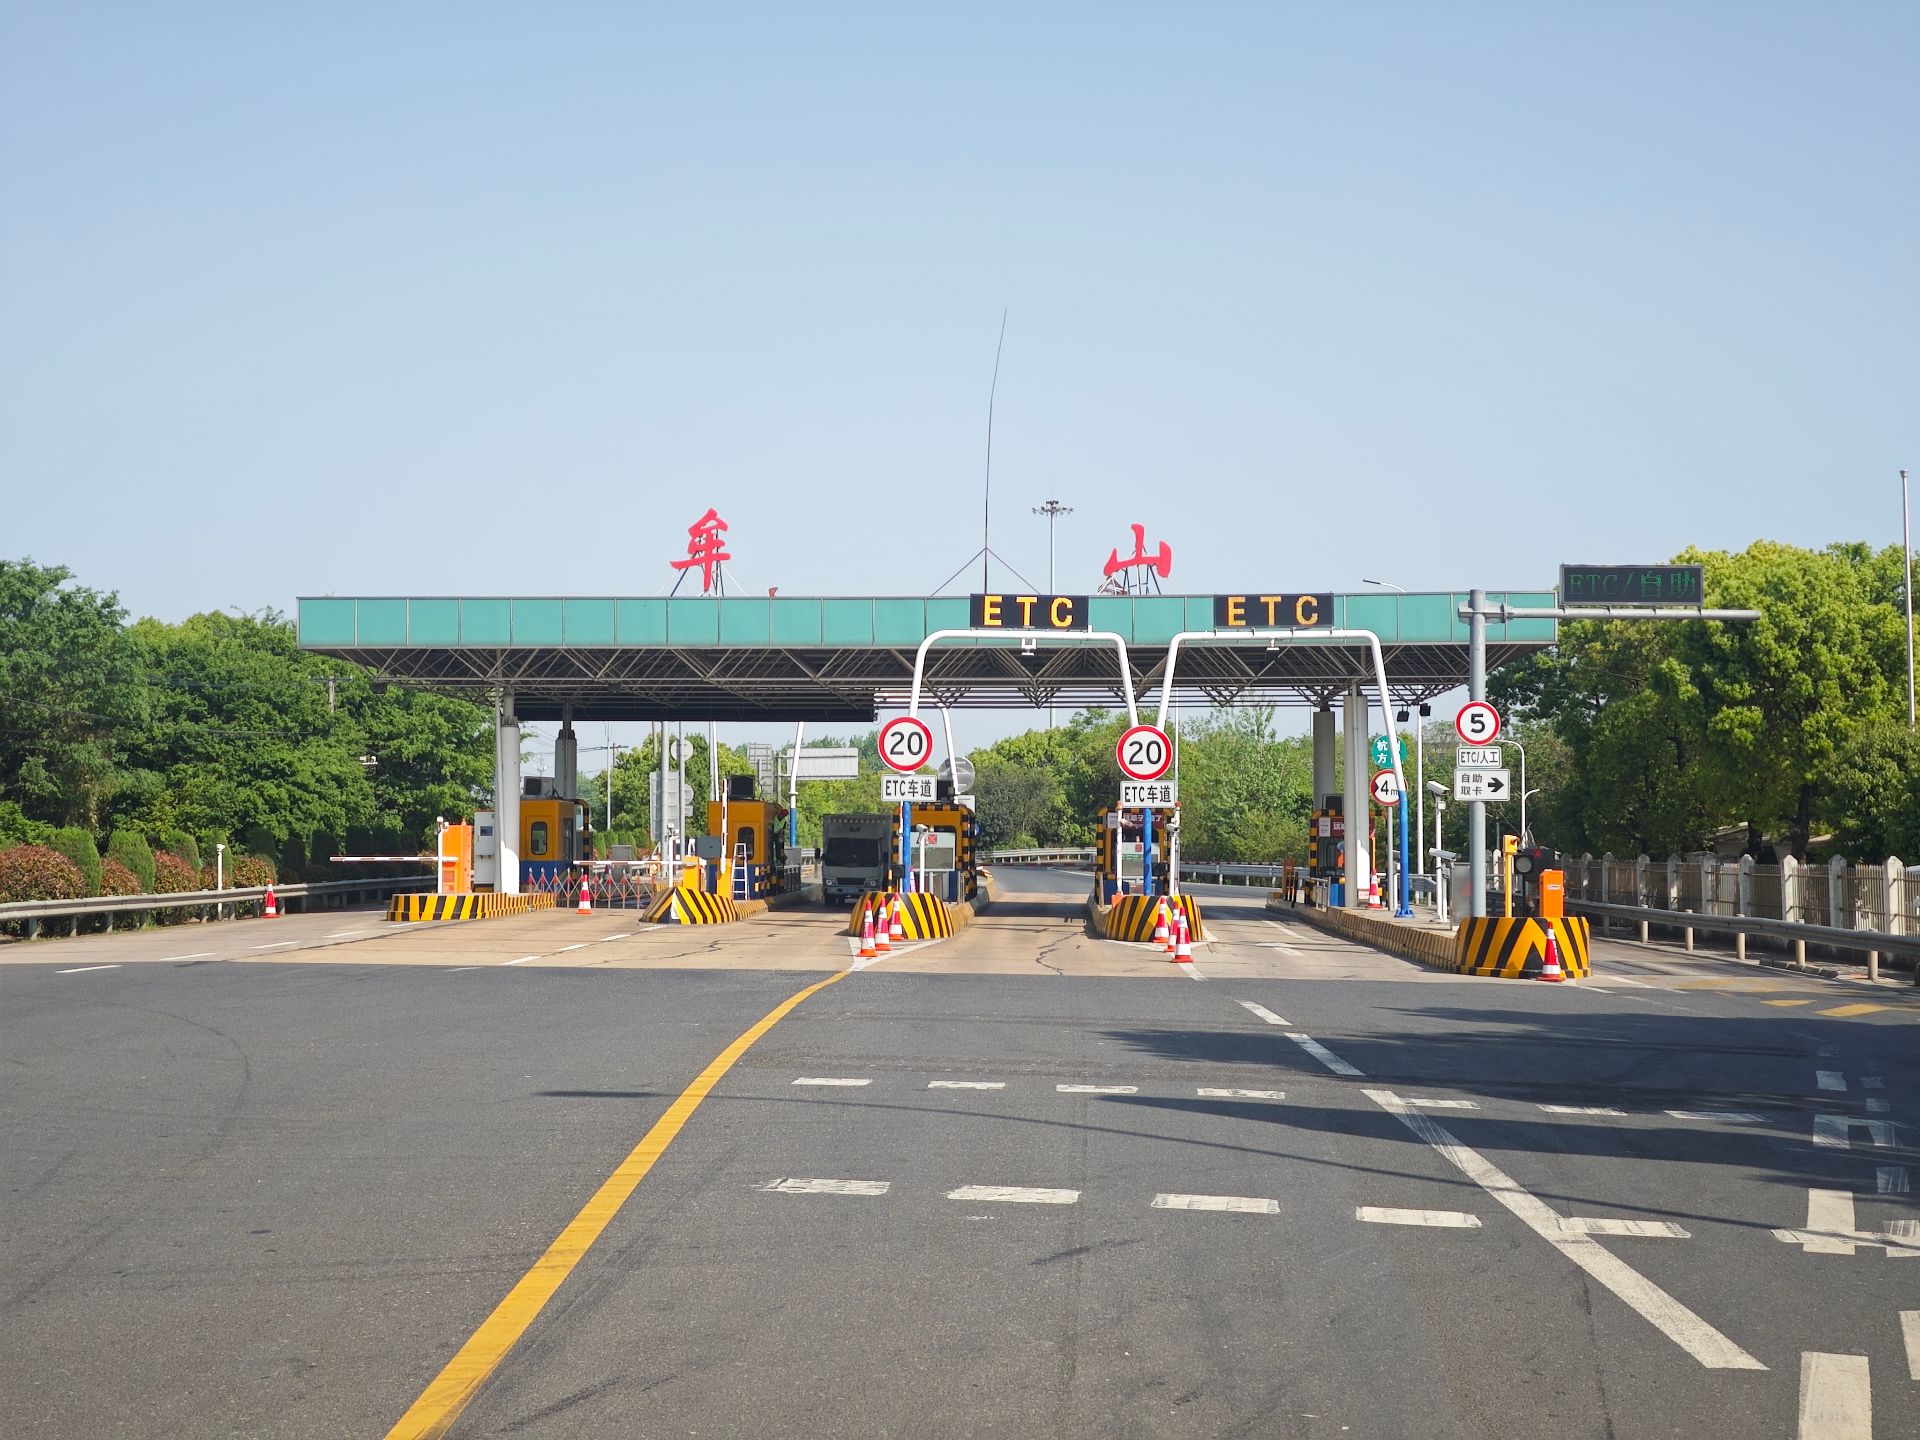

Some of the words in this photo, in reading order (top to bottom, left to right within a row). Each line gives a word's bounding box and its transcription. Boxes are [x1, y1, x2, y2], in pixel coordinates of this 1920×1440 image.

[1103, 523, 1172, 579] 山
[983, 595, 1074, 627] ETC
[1227, 595, 1319, 626] ETC
[1470, 713, 1486, 734] 5
[889, 731, 923, 756] 20
[1128, 740, 1162, 765] 20
[1460, 750, 1499, 764] ETC/人工
[885, 779, 932, 797] ETC车道
[1461, 773, 1483, 784] 自助
[1124, 785, 1172, 803] ETC车道
[1461, 785, 1483, 796] 取卡
